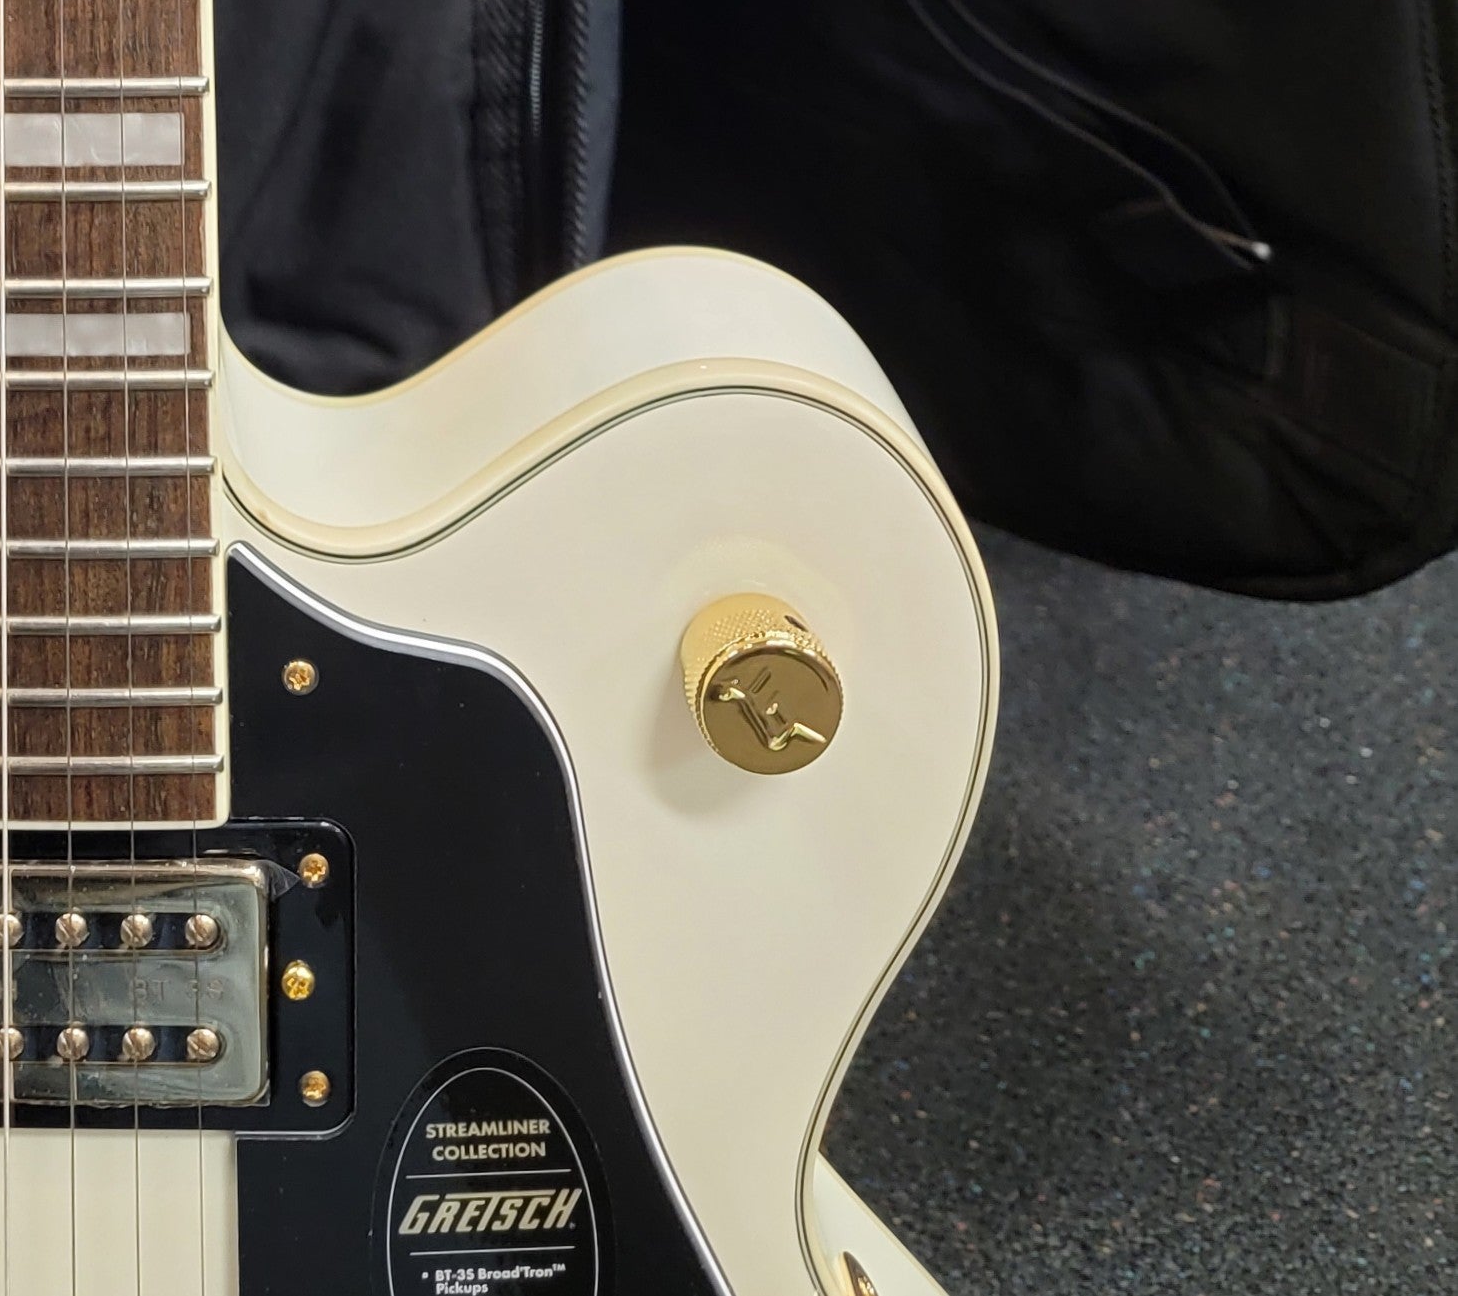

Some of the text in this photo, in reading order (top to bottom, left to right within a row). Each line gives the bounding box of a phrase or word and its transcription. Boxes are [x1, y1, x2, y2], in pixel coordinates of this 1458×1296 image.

[425, 1118, 551, 1139] STREAMLINER
[431, 1141, 547, 1161] COLLECTION
[398, 1188, 583, 1235] GRETSCH
[435, 1281, 489, 1296] Pickups
